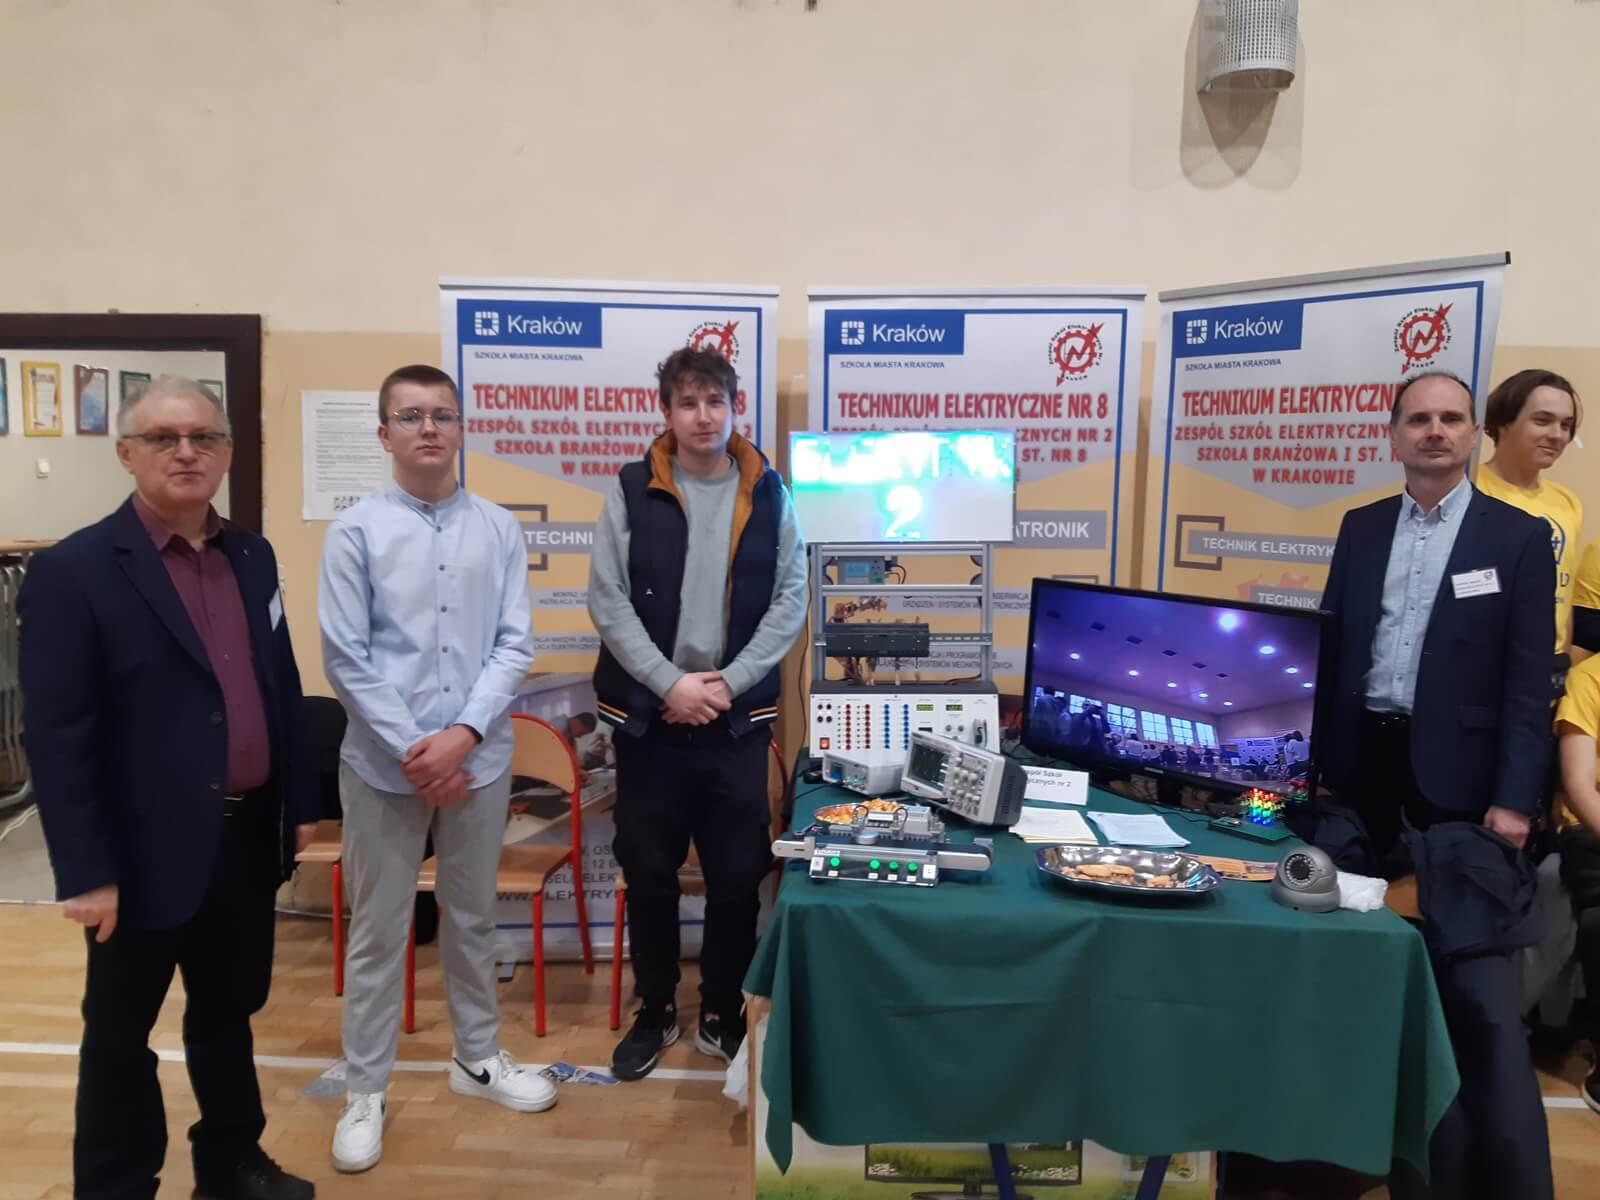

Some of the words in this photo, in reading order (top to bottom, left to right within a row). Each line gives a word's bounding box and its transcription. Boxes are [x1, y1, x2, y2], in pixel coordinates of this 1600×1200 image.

[507, 315, 583, 336] Kraków
[872, 323, 946, 343] Kraków
[1214, 317, 1284, 340] Kraków
[874, 361, 902, 369] MIASTA
[904, 361, 945, 369] KRAKOWA
[1214, 360, 1241, 369] MIASTA
[1243, 358, 1282, 367] KRAKOWA
[472, 383, 579, 411] TECHNIKUM
[584, 386, 660, 412] ELEKTRY
[838, 391, 940, 418] TECHNIKUM
[944, 392, 1063, 418] ELEKTRYCZNE
[1067, 393, 1092, 419] NR
[1096, 393, 1108, 419] 8
[1182, 387, 1275, 416] TECHNIKUM
[467, 415, 526, 434] ZESPÓŁ
[530, 416, 580, 435] SZKÓŁ
[586, 421, 669, 436] ELEKTRYC
[1175, 421, 1225, 441] ZESPÓŁ
[1229, 420, 1273, 441] SZKÓŁ
[1279, 422, 1392, 440] ELEKTRYCZNY
[1077, 428, 1099, 443] NR
[1104, 428, 1113, 443] 2
[495, 439, 554, 455] SZKOŁA
[560, 439, 646, 456] BRANŻOWA
[1022, 448, 1045, 463] ST.
[1051, 448, 1073, 463] NR
[1077, 449, 1087, 463] 8
[1197, 446, 1248, 461] SZKOŁA
[1253, 443, 1338, 462] BRANŻOWA
[1344, 446, 1352, 462] I
[1357, 446, 1382, 462] ST.
[561, 461, 576, 475] W
[1253, 469, 1267, 483] W
[1271, 468, 1355, 485] KRAKOWIE
[525, 531, 593, 545] TECHNI
[1202, 537, 1257, 552] TECHNIK
[1261, 541, 1336, 557] ELEKTRYK
[1257, 592, 1317, 610] TECHNIK
